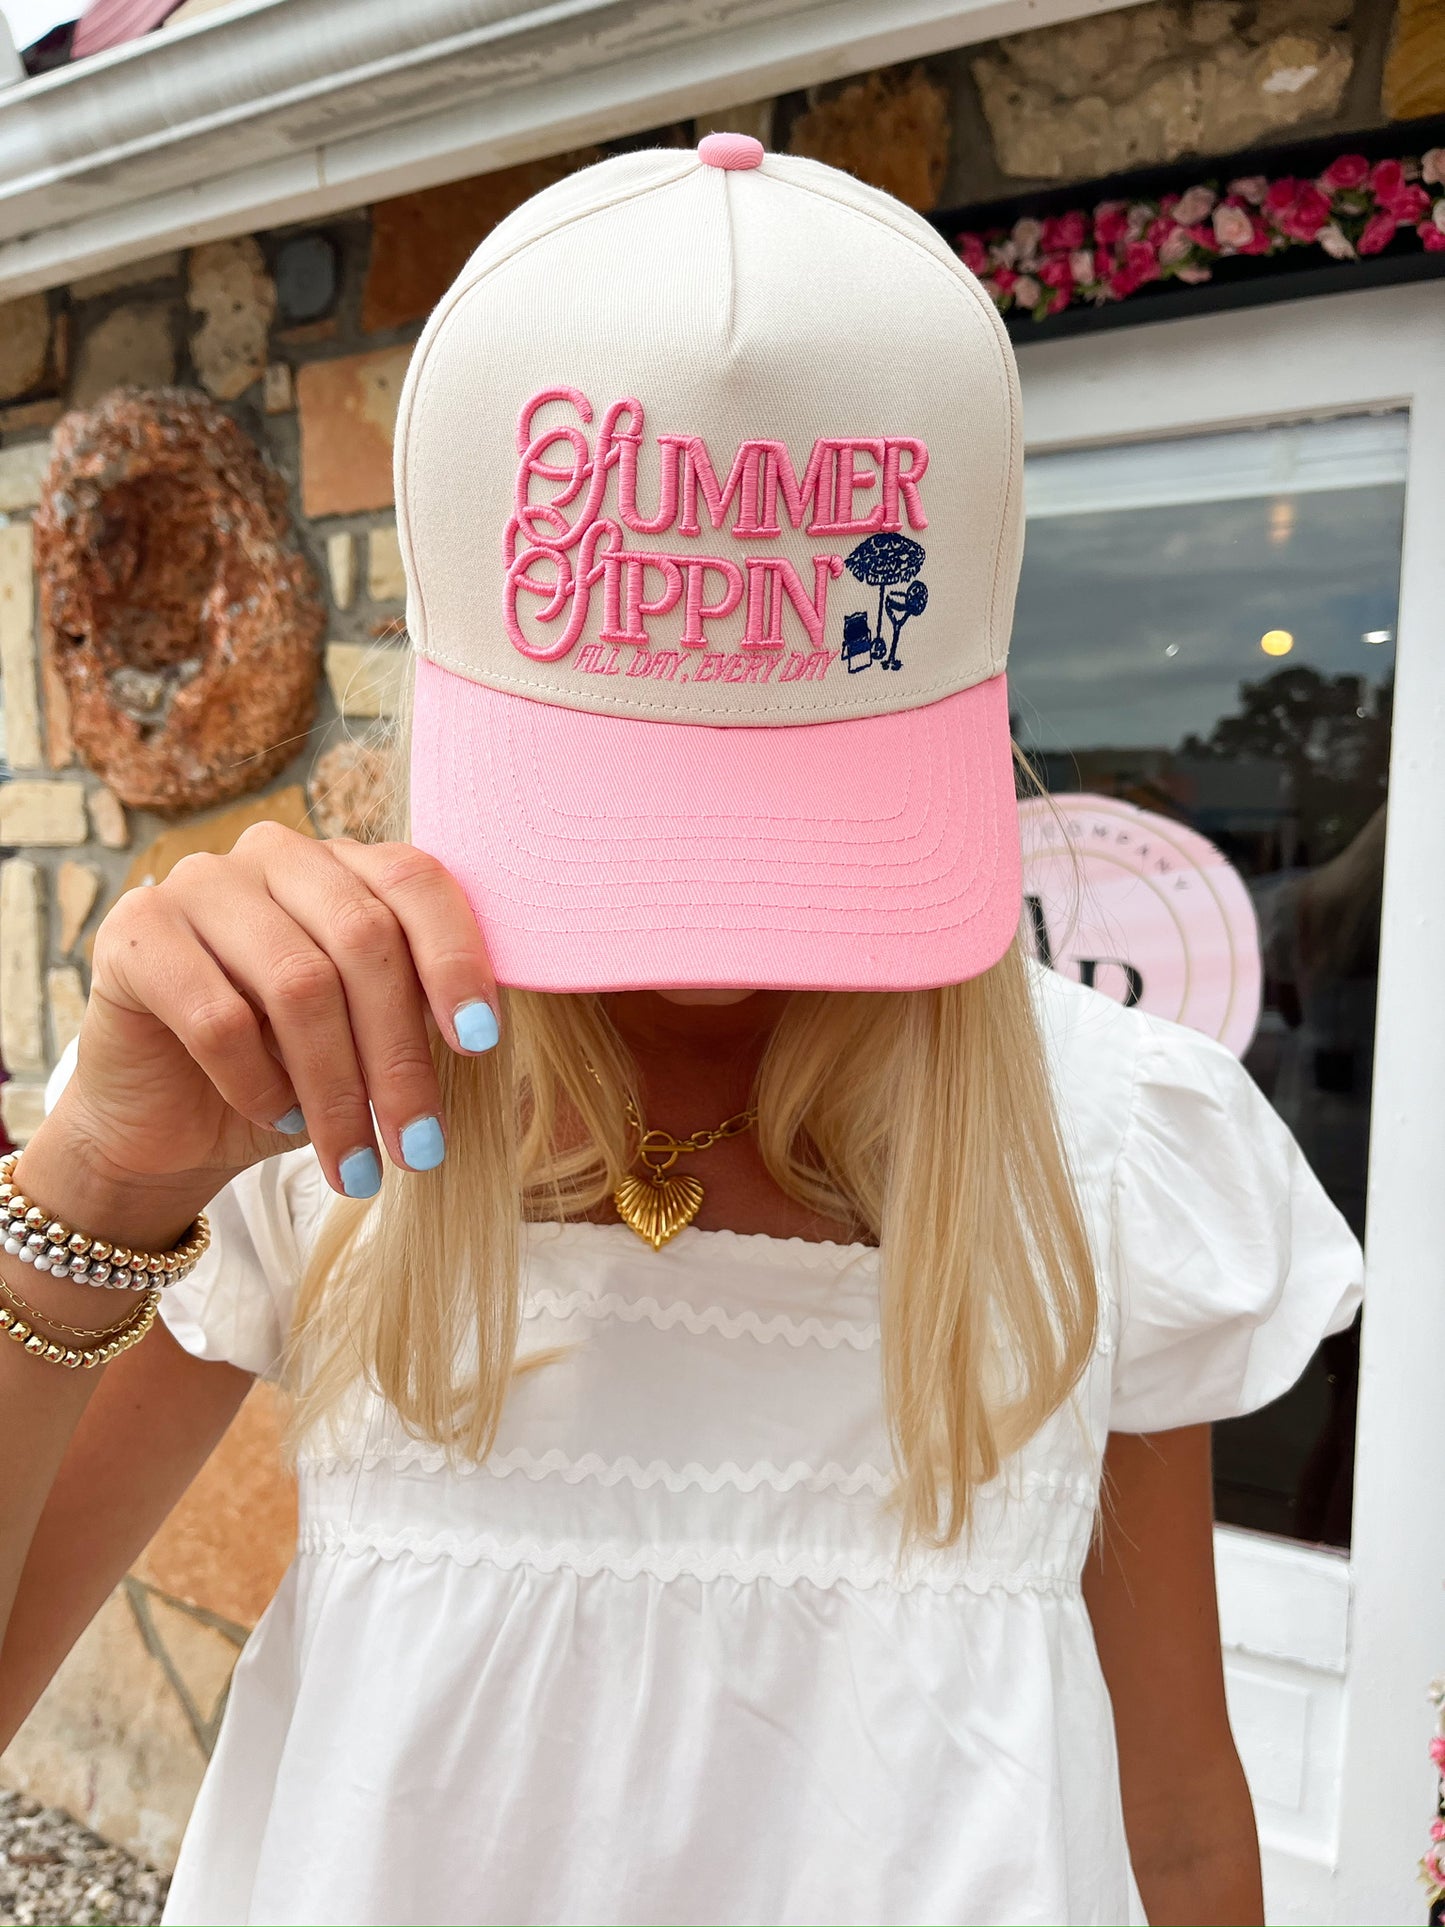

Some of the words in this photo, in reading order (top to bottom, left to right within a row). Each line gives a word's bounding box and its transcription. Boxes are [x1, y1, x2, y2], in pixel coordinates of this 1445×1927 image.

[515, 384, 930, 551] SUMMER
[501, 504, 845, 663] SIPPIN'
[572, 643, 621, 676] ALL
[625, 649, 691, 684] DAY,
[692, 651, 783, 684] EVERY
[777, 649, 840, 683] DAY
